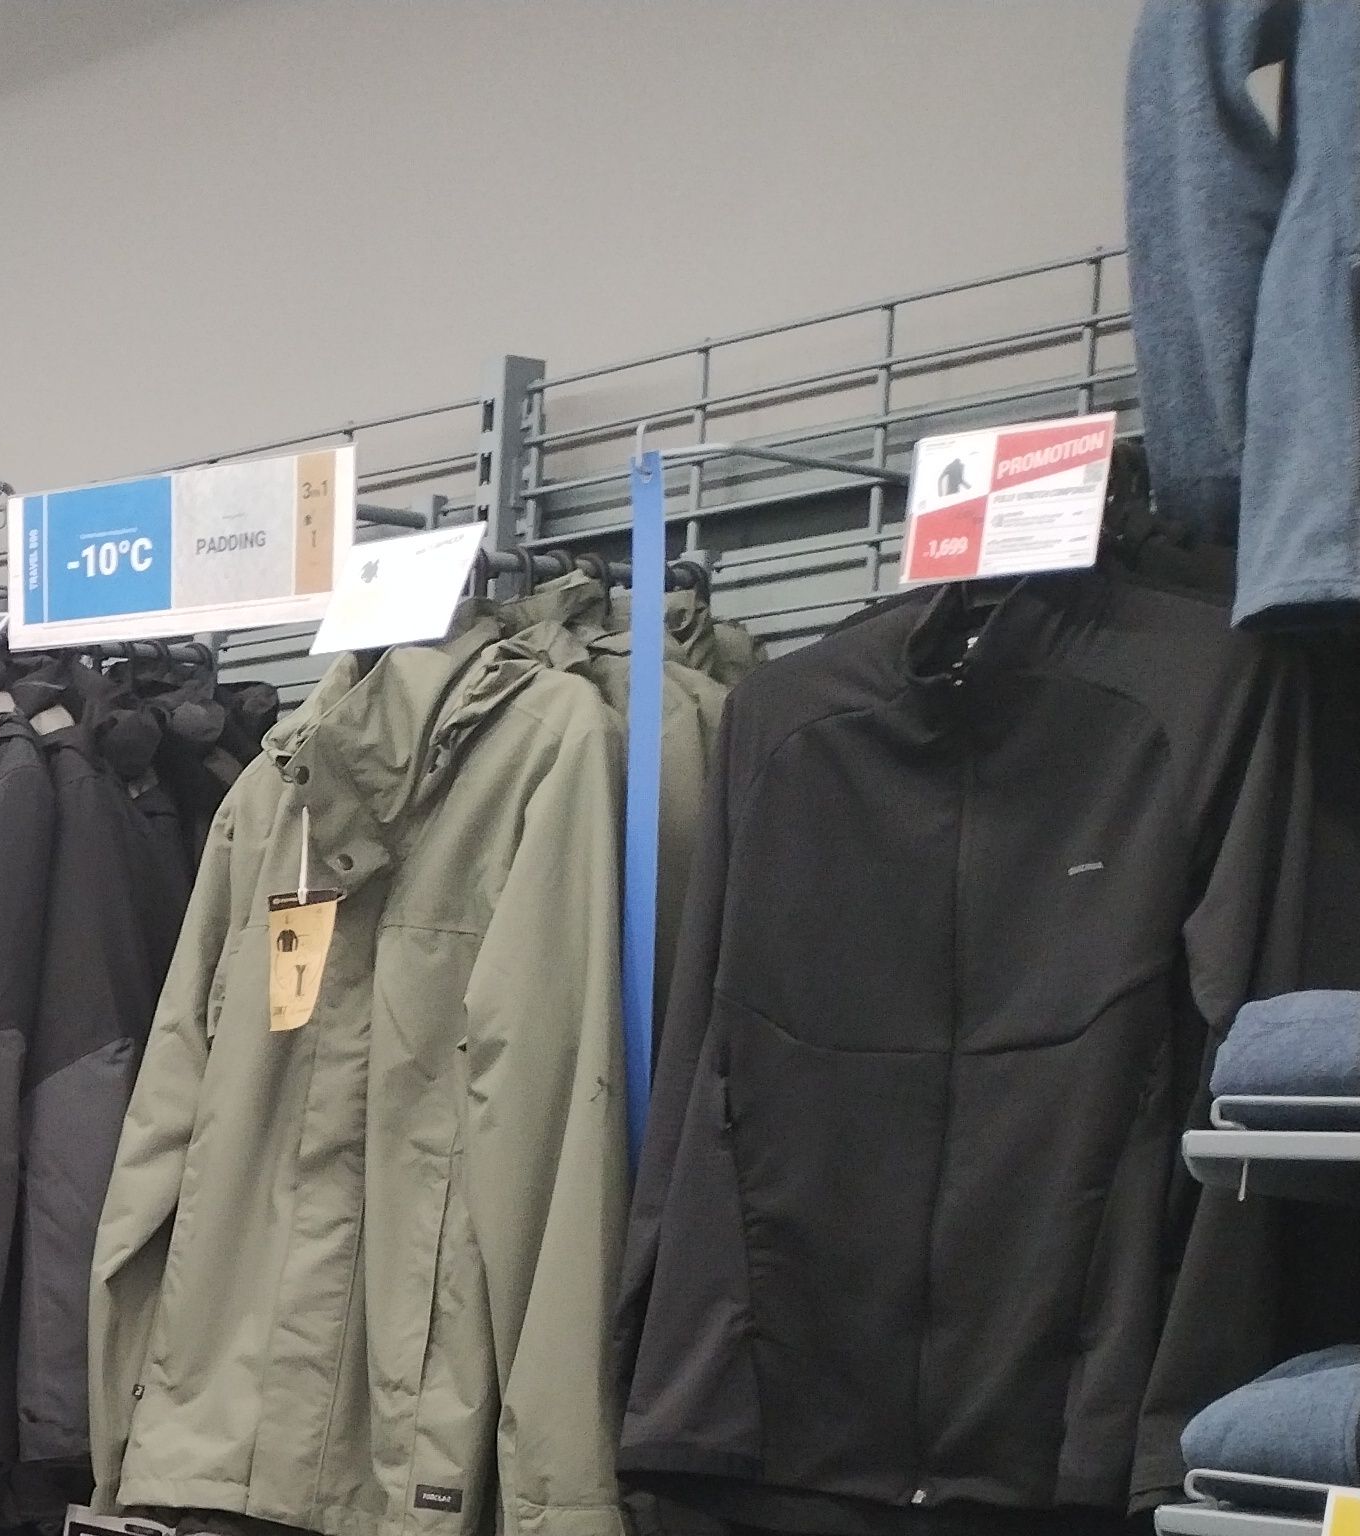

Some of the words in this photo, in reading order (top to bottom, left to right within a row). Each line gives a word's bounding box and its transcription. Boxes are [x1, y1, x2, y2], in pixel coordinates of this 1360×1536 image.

[996, 431, 1106, 480] PROMOTION
[66, 536, 154, 578] -10°C
[195, 530, 267, 556] PADDING
